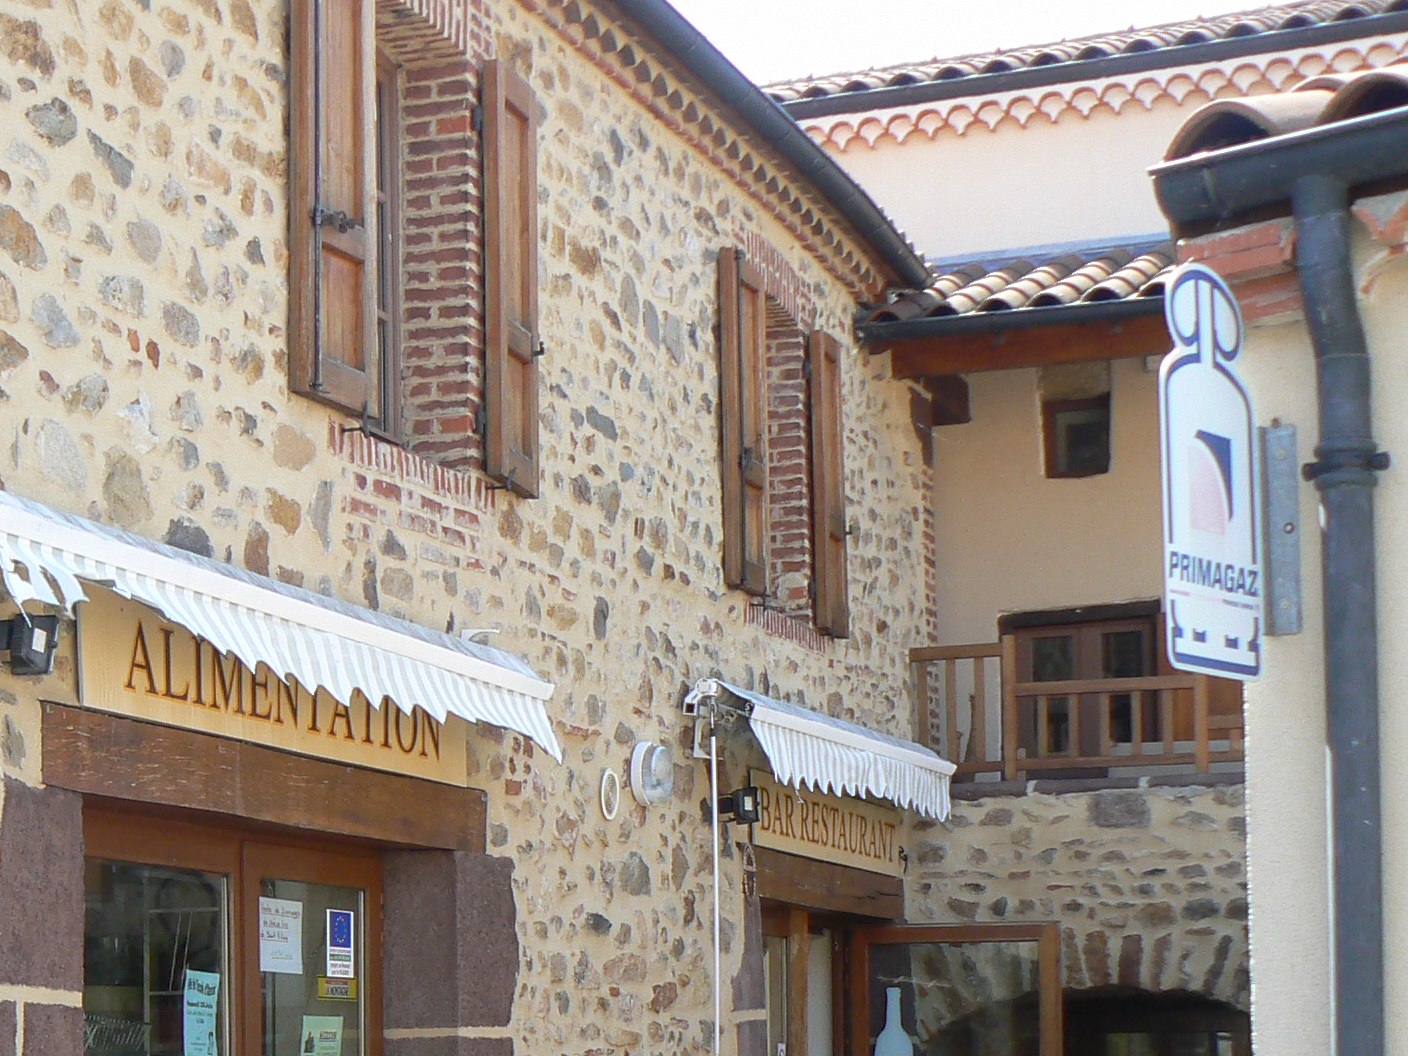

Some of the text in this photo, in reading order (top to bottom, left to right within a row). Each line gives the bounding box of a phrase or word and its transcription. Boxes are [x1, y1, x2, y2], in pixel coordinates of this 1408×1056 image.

[1169, 550, 1260, 598] PRIMAGAZ
[125, 619, 442, 761] ALIMENTATION
[758, 786, 896, 863] BAR RESTAURANT
